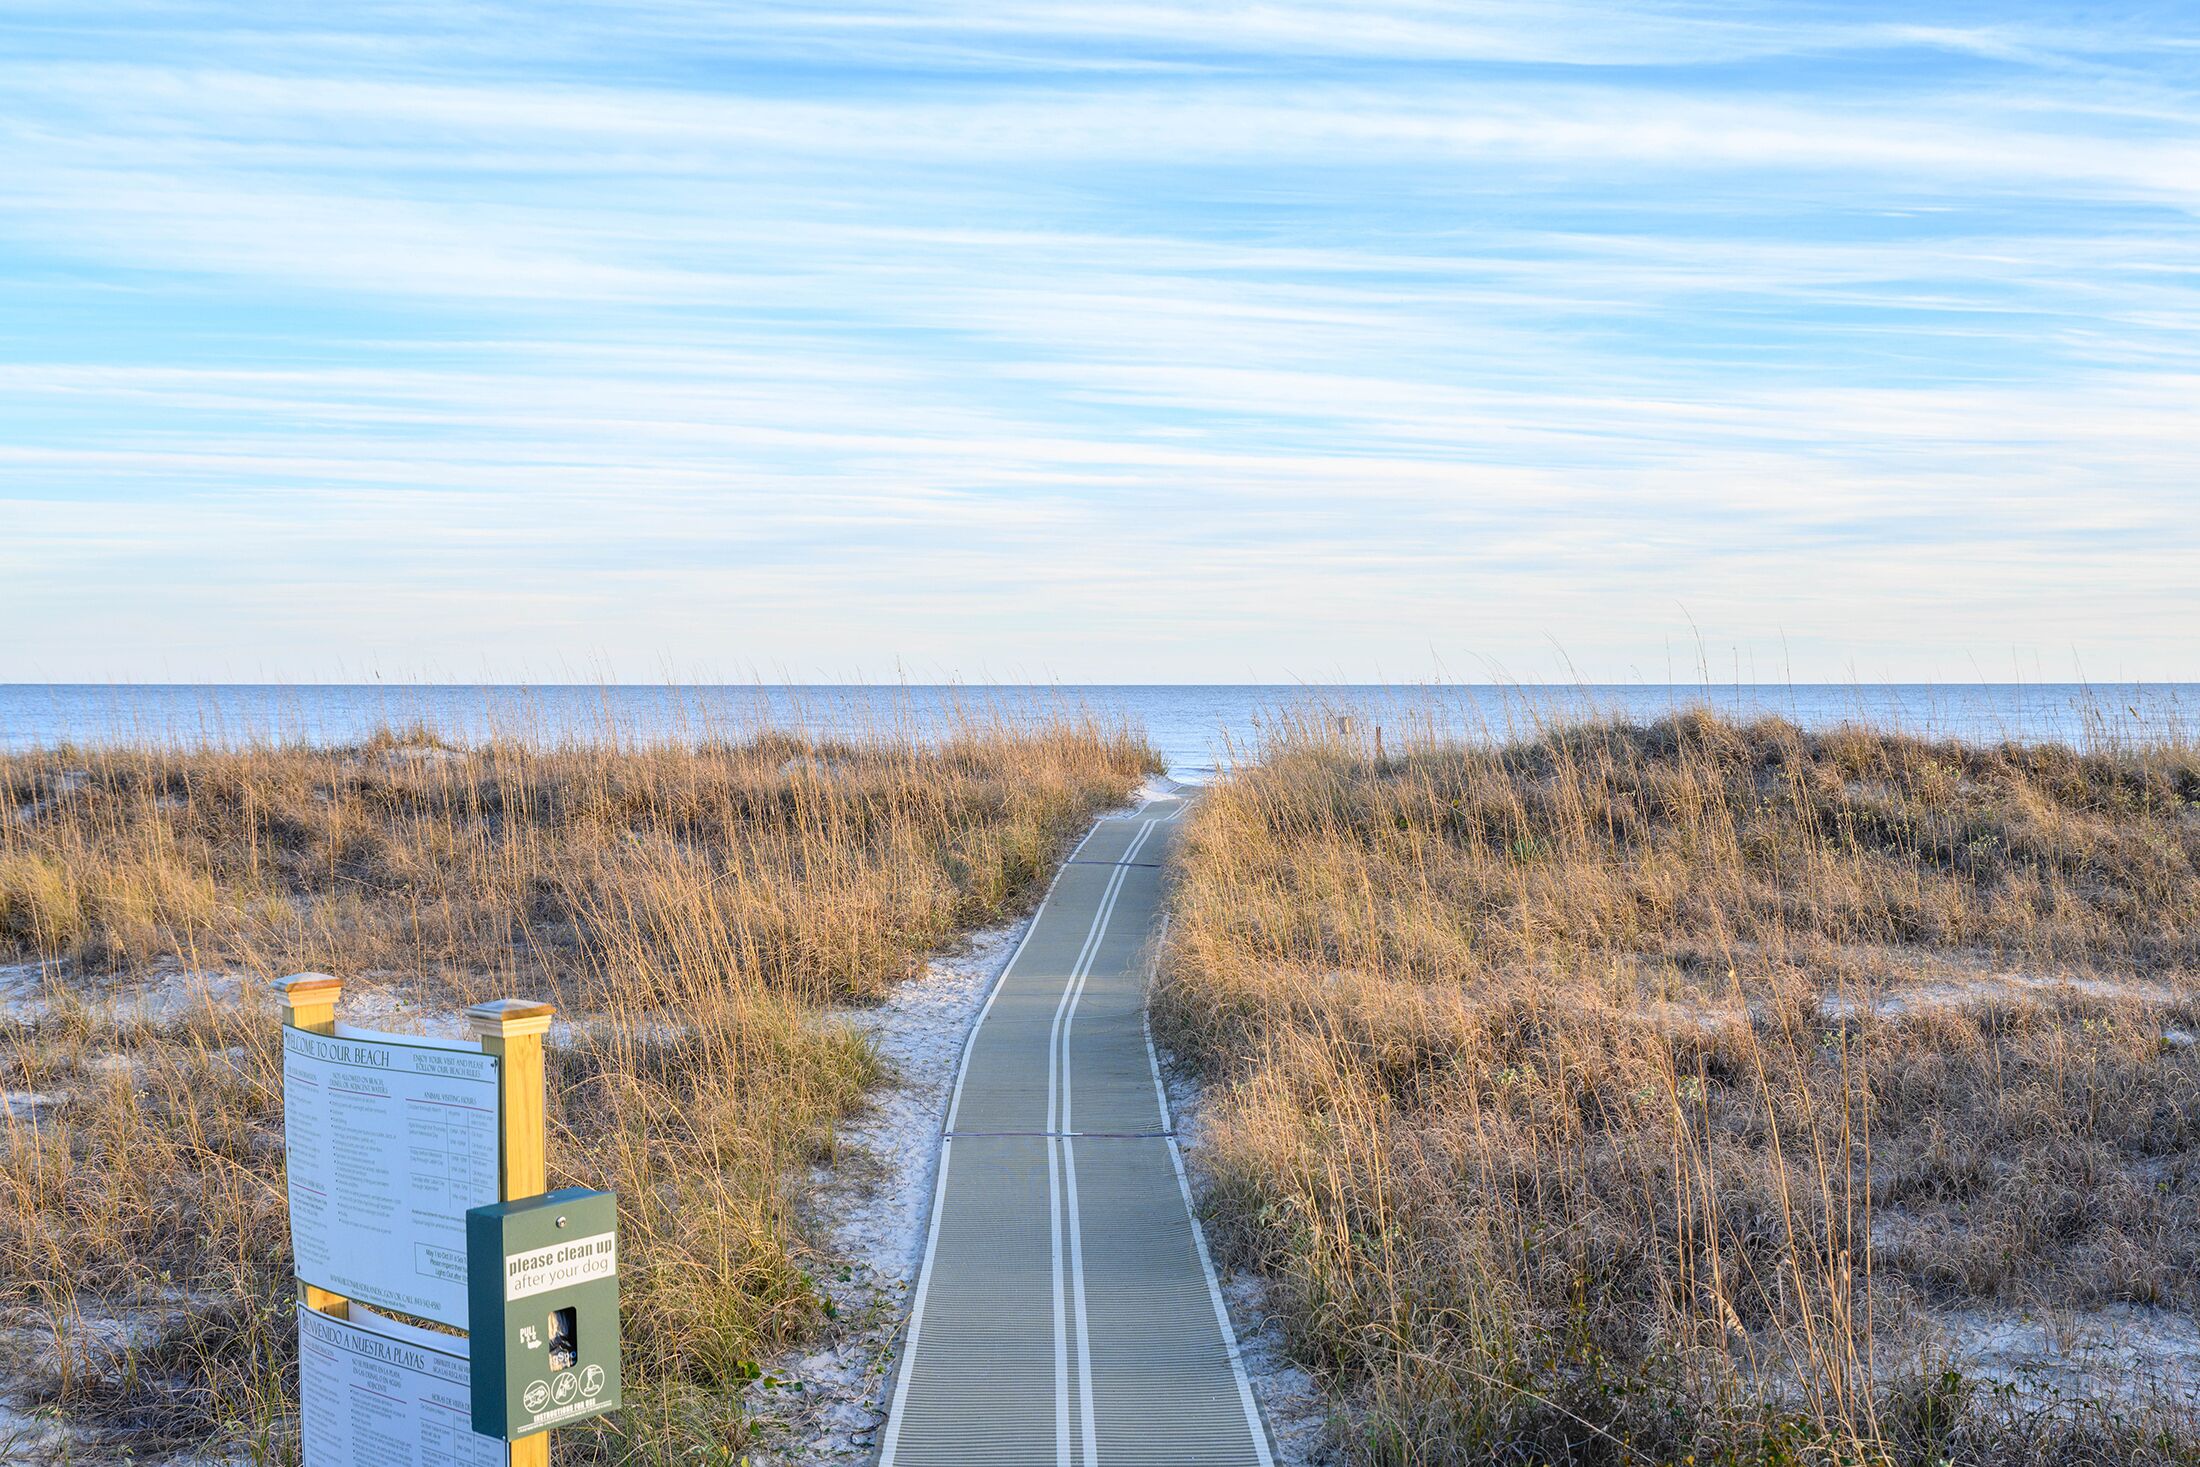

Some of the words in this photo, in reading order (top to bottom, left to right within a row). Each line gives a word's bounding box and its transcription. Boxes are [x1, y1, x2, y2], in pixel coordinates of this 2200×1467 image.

[286, 1033, 315, 1055] WELCOME
[316, 1041, 327, 1058] TO
[329, 1044, 351, 1062] OUR
[354, 1048, 390, 1067] BEACH
[413, 1054, 428, 1064] ENJOY
[428, 1056, 442, 1064] YOUR
[443, 1057, 455, 1066] VISIT
[456, 1058, 468, 1067] AND
[468, 1060, 484, 1070] PLEASE
[416, 1063, 436, 1072] FOLLOW
[437, 1065, 448, 1074] OUR
[449, 1066, 465, 1076] BEACH
[509, 1253, 553, 1276] please
[557, 1244, 592, 1263] clean
[596, 1240, 612, 1254] up
[514, 1272, 546, 1290] after
[549, 1265, 579, 1285] your
[582, 1258, 608, 1273] dog
[303, 1318, 342, 1345] BIENVENIDO
[344, 1334, 350, 1346] A
[352, 1336, 391, 1360] NUESTRA
[394, 1347, 424, 1370] PLAYAS
[520, 1325, 536, 1338] PULL
